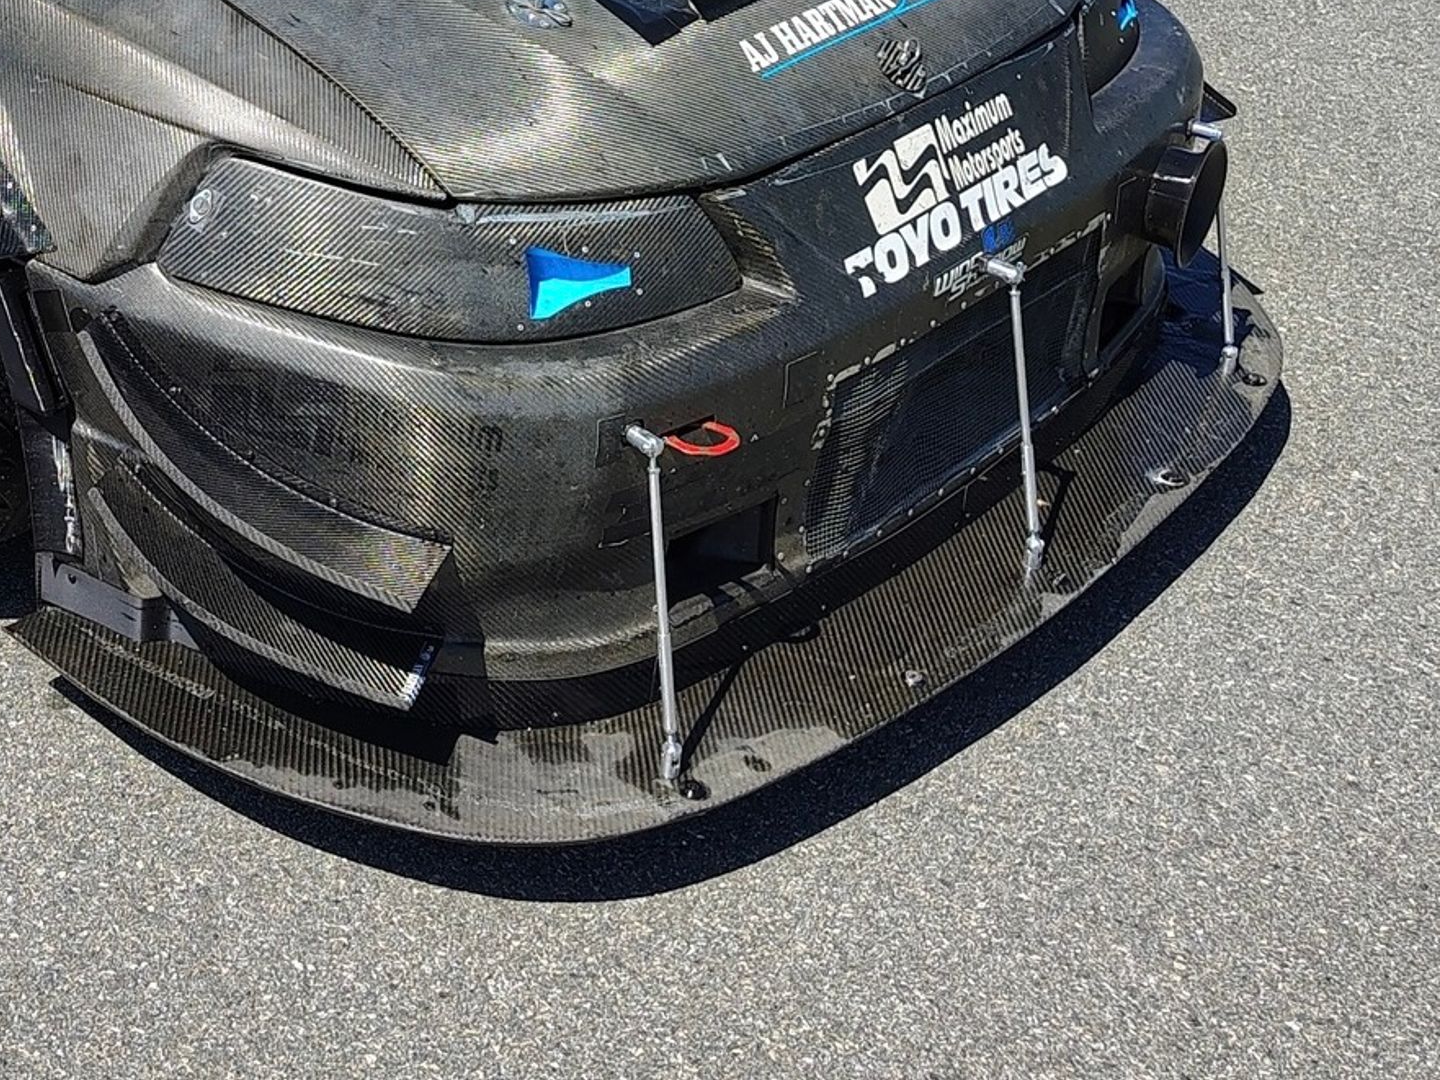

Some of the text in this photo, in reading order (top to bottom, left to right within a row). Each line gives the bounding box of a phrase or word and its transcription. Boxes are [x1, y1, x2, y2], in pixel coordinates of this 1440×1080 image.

[738, 31, 780, 72] AJ
[935, 93, 1014, 154] Maximum
[948, 128, 1026, 191] Motorsports
[844, 201, 962, 299] TOYO
[959, 143, 1068, 232] TIRES
